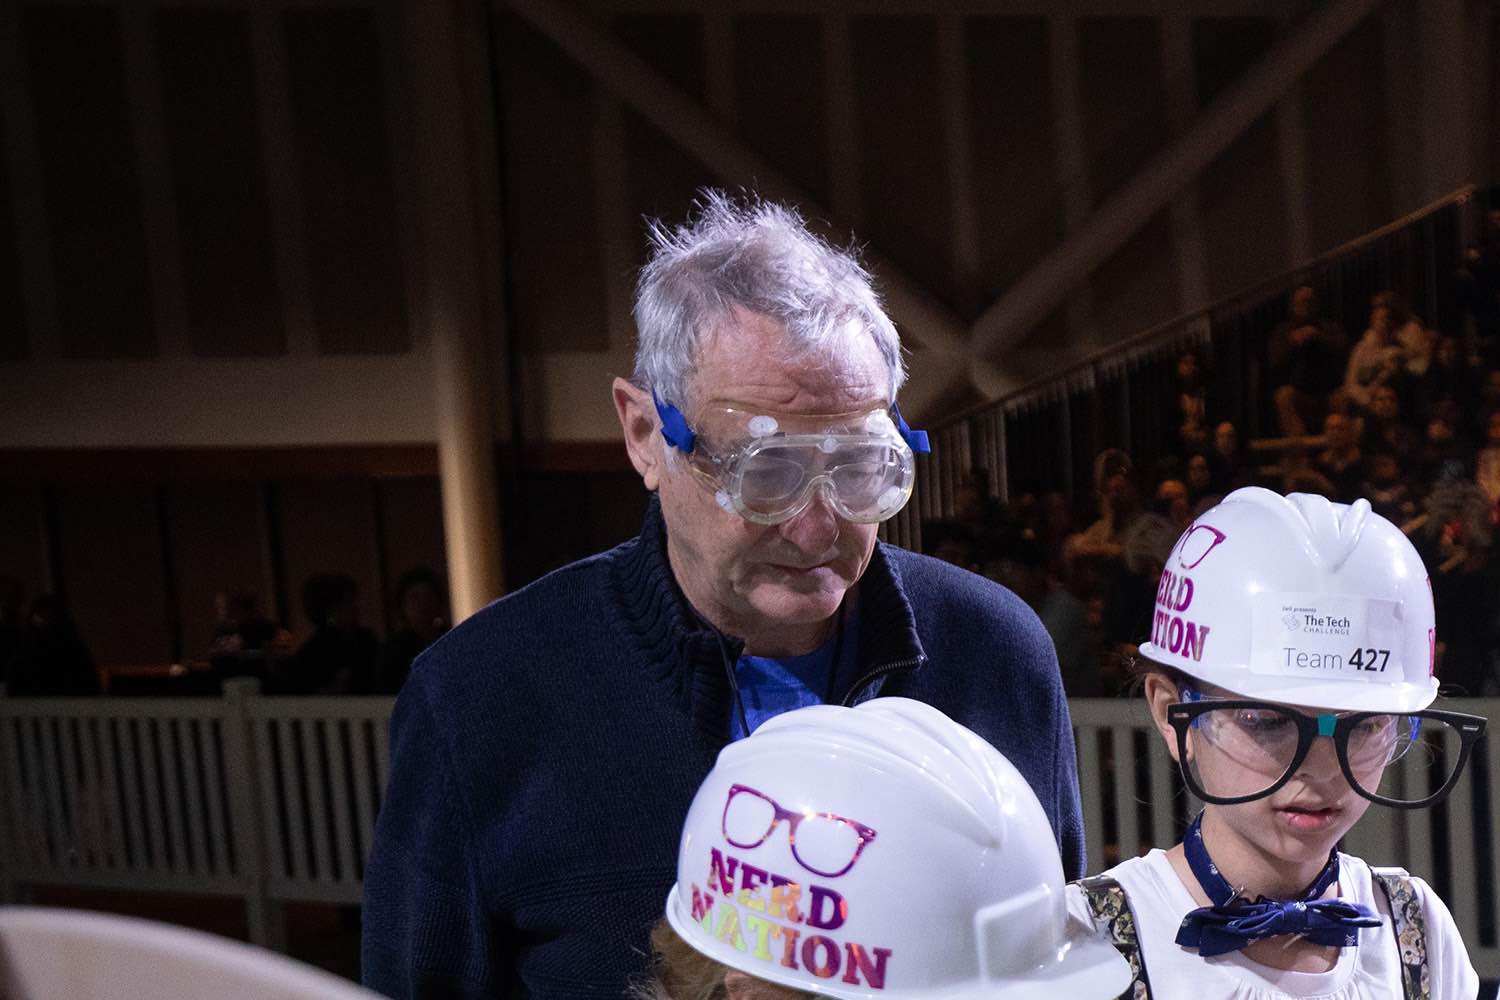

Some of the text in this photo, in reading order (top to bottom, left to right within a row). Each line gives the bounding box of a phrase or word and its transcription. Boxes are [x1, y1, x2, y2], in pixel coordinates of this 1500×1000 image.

[1156, 568, 1195, 612] ERD
[1153, 609, 1210, 662] TION
[1304, 614, 1351, 628] The Tech
[1304, 626, 1351, 636] CHALLENGE
[1283, 647, 1391, 673] Team 427
[707, 846, 849, 931] NERD
[690, 882, 893, 990] NATION
